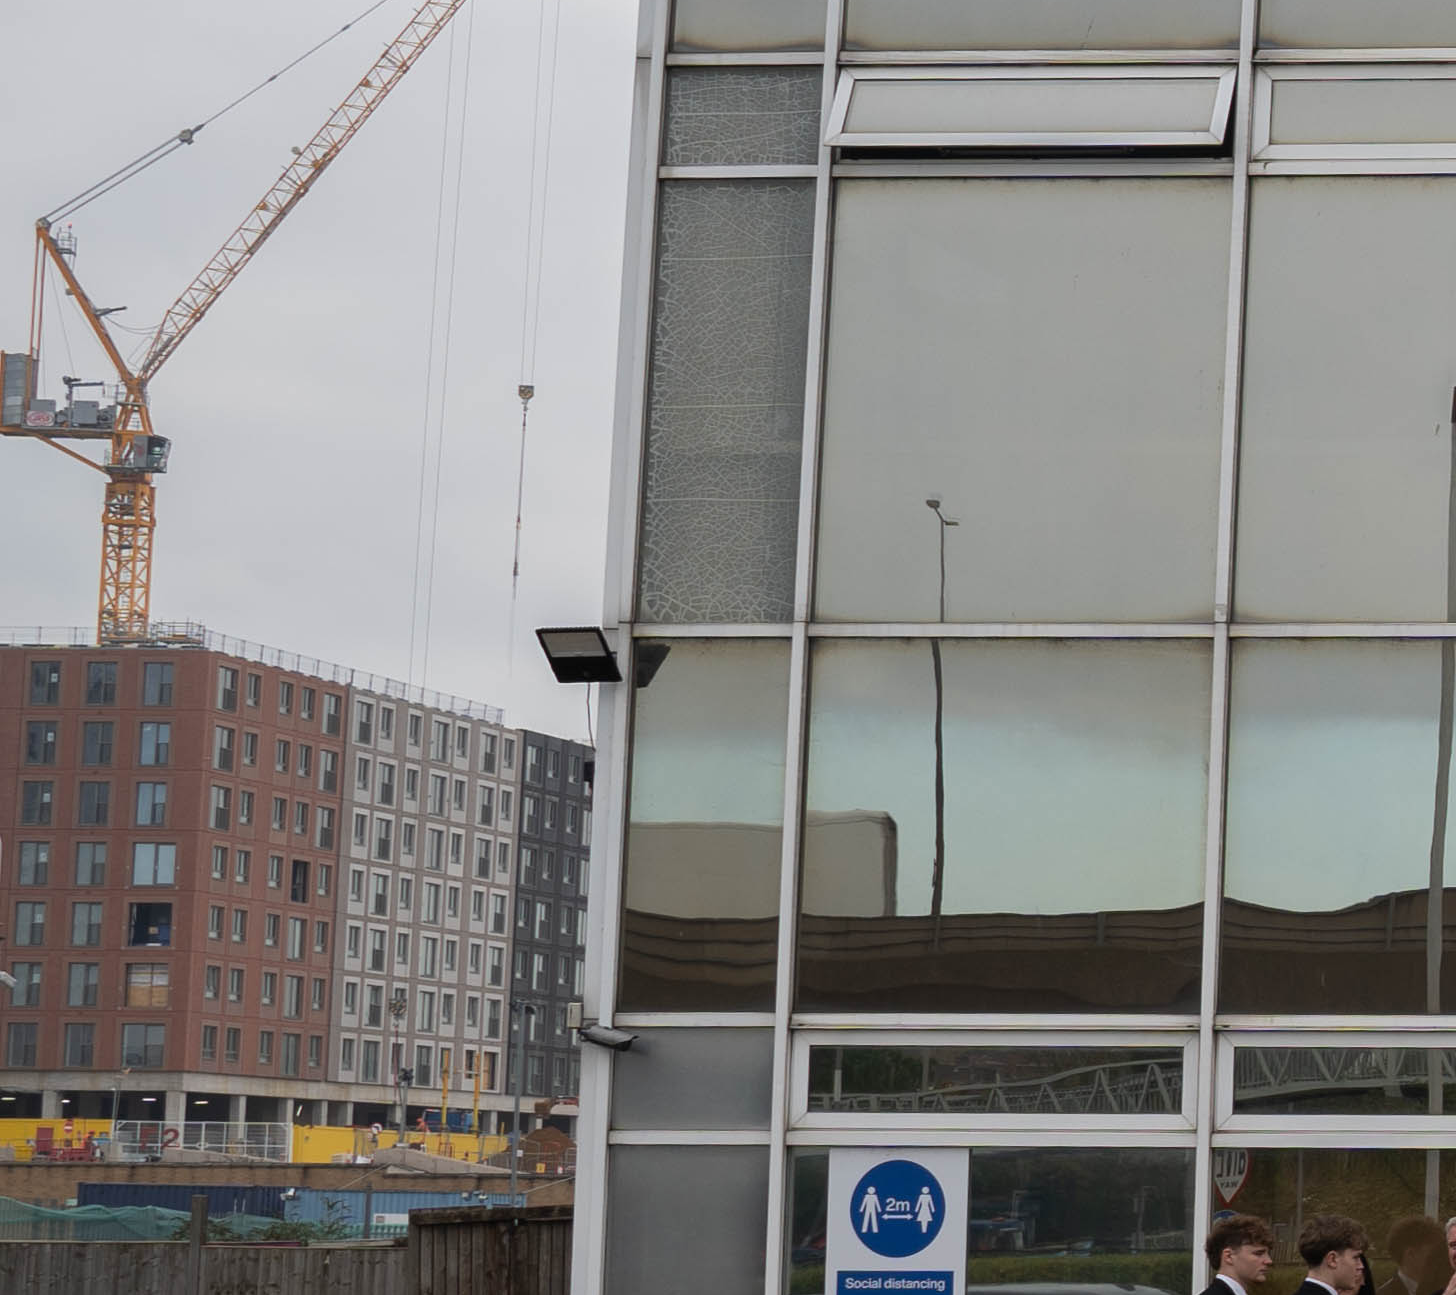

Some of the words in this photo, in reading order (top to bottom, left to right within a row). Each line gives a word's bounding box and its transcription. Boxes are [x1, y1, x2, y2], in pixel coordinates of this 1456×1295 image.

[886, 1197, 910, 1211] 2m
[845, 1277, 882, 1289] Social
[883, 1278, 946, 1292] distancing
